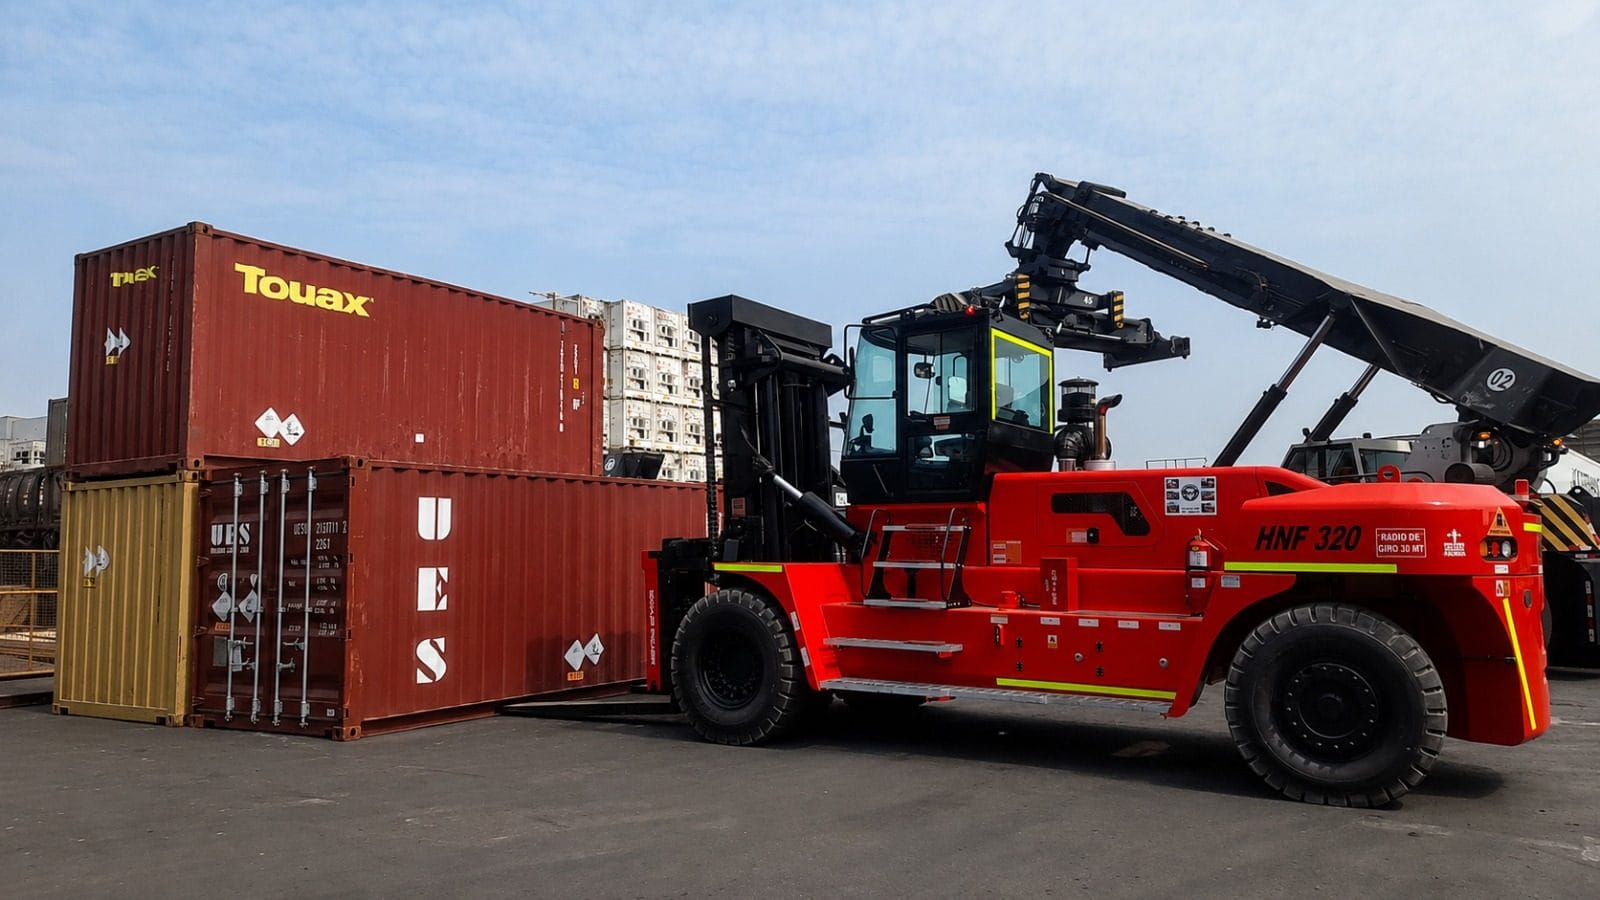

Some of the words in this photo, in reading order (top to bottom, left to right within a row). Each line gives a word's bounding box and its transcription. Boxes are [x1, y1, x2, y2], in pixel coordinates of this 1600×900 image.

[234, 262, 371, 318] Touax
[1490, 370, 1513, 389] 02
[1254, 525, 1311, 551] HNF
[1313, 525, 1362, 551] 320
[1380, 532, 1407, 542] RADIO
[1408, 532, 1421, 542] DE
[1378, 544, 1399, 553] GIRO
[1400, 544, 1411, 553] 30
[1411, 544, 1425, 553] MT
